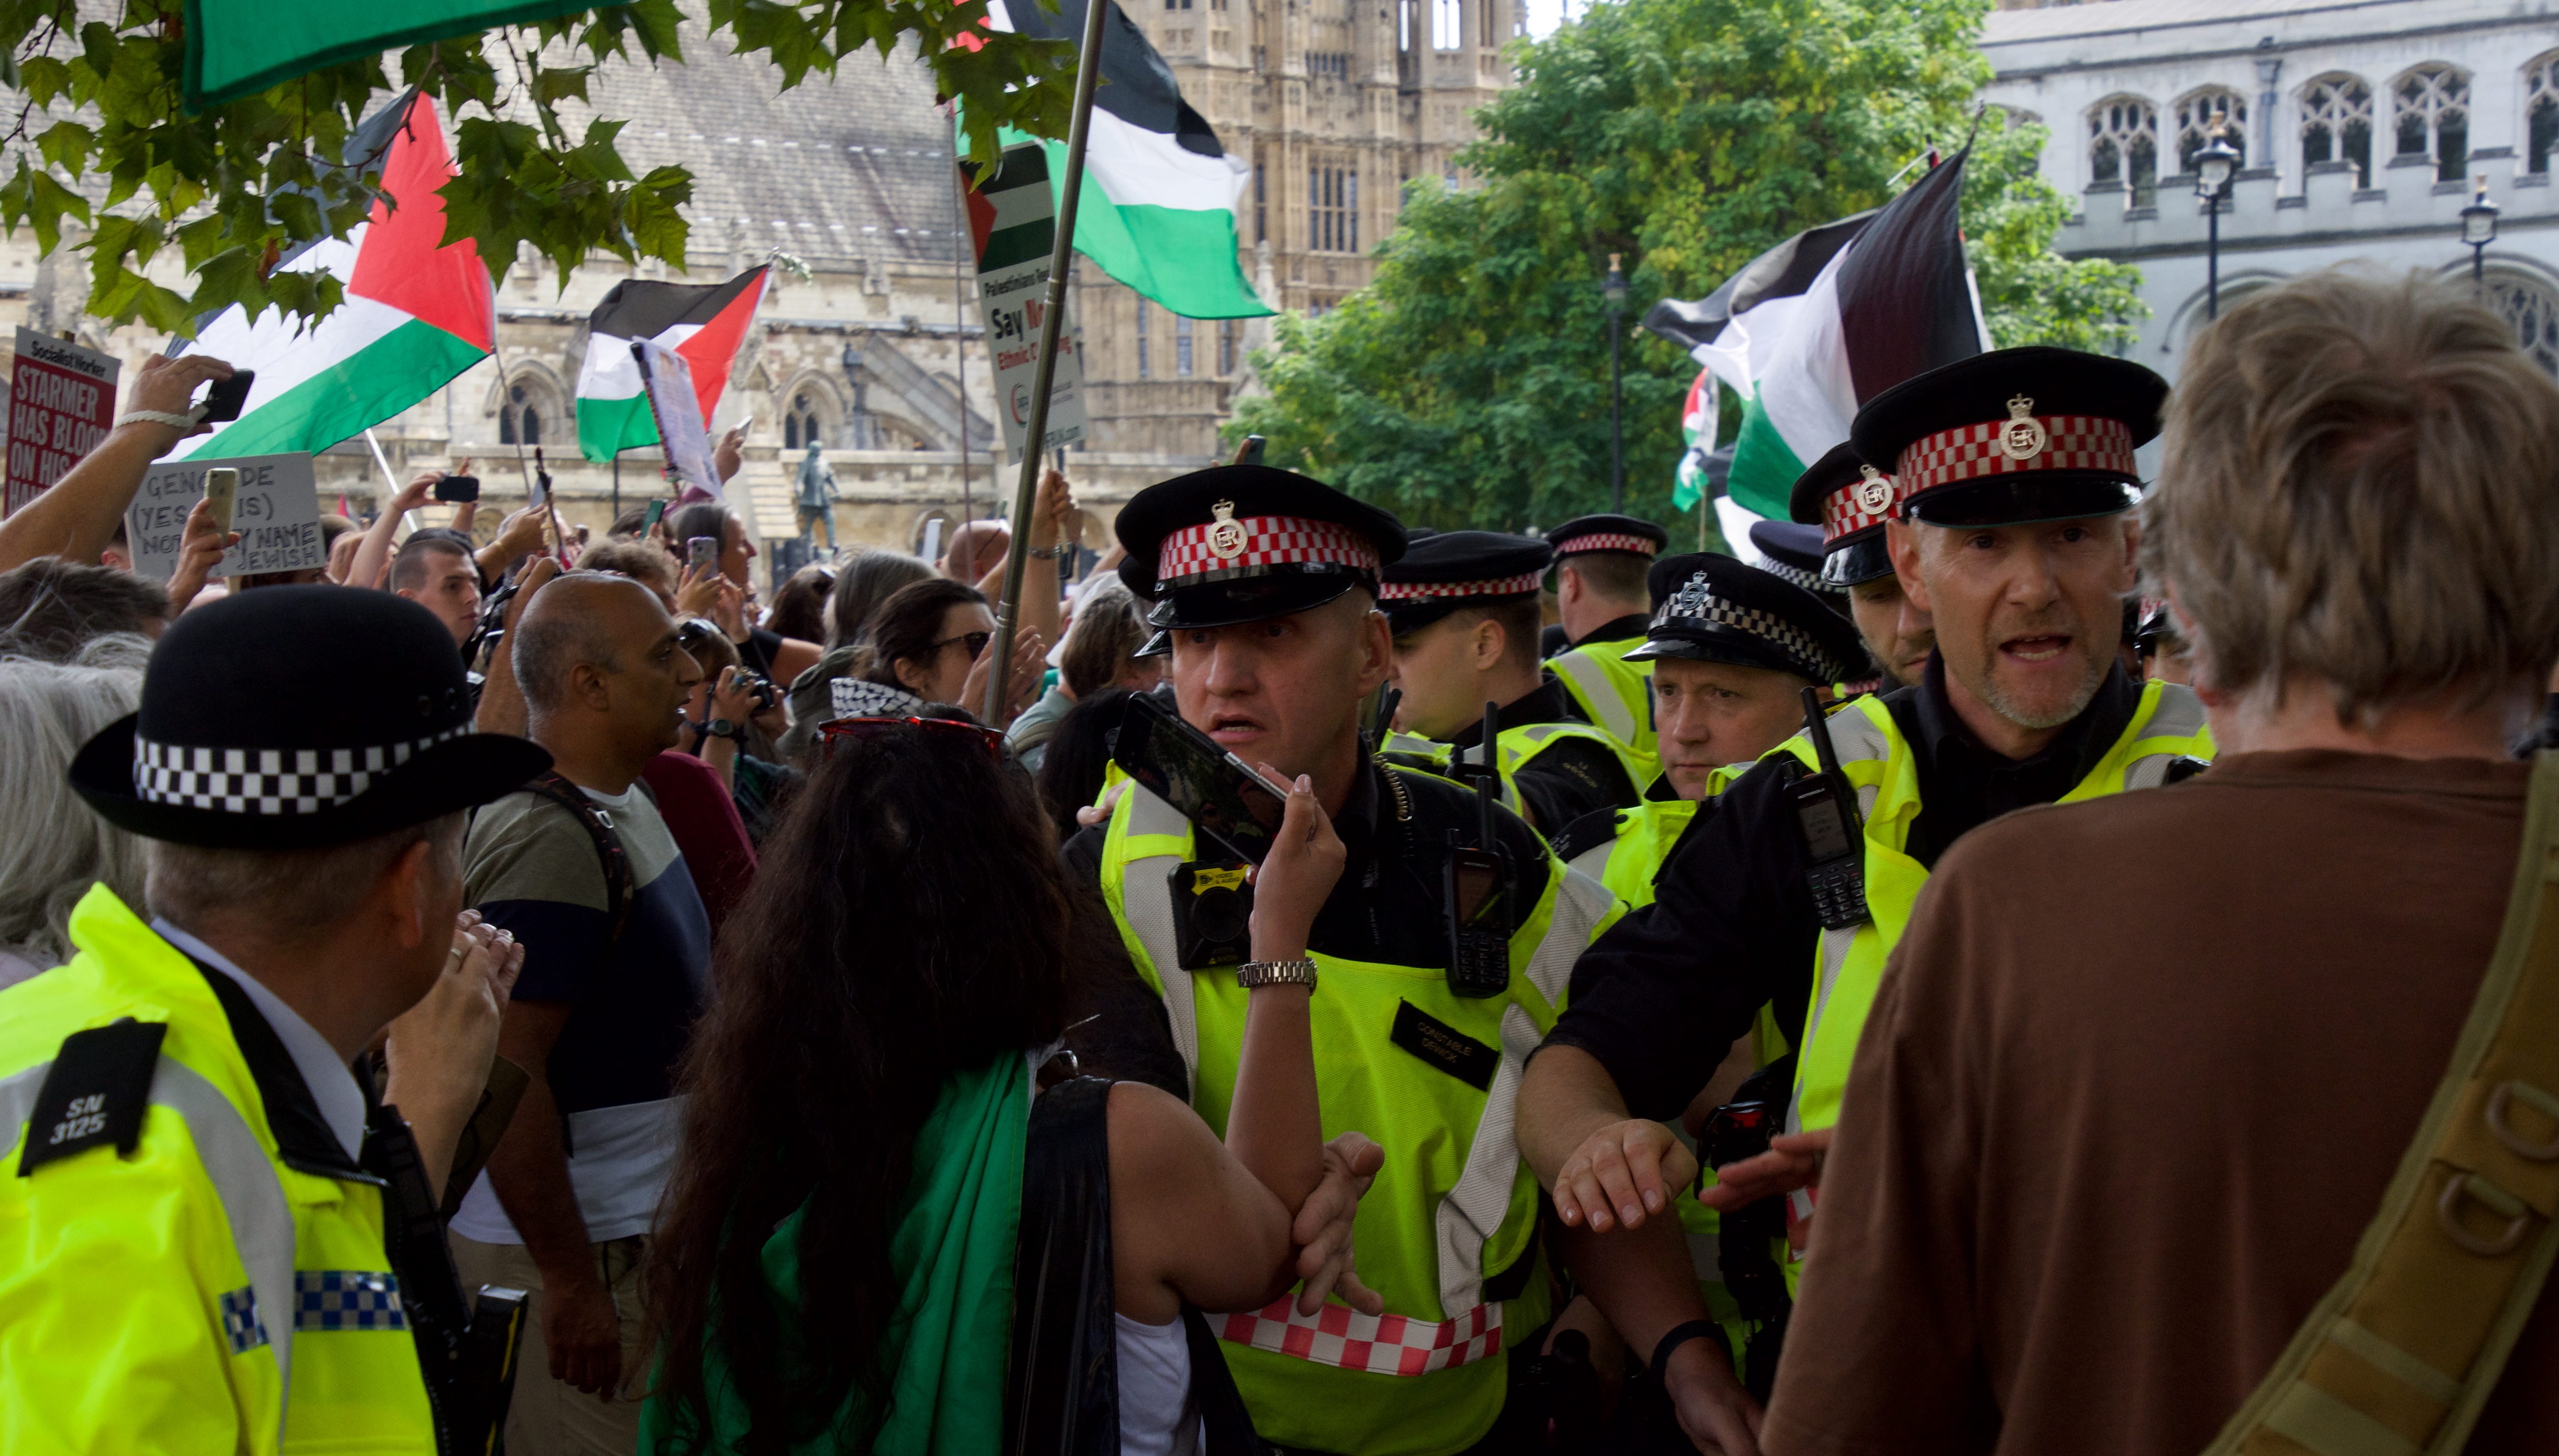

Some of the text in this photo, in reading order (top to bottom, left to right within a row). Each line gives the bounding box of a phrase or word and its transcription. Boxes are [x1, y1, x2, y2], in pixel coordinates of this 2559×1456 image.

[992, 308, 1024, 342] Say
[31, 340, 75, 368] Socialist
[17, 365, 99, 421] STARMER
[13, 403, 50, 446] HAS
[11, 441, 37, 481] ON
[256, 522, 318, 549] NAME
[237, 546, 319, 570] JEWISH
[1417, 1021, 1473, 1056] CONSTABLE
[66, 1093, 106, 1119] SN
[49, 1112, 107, 1145] 3125
